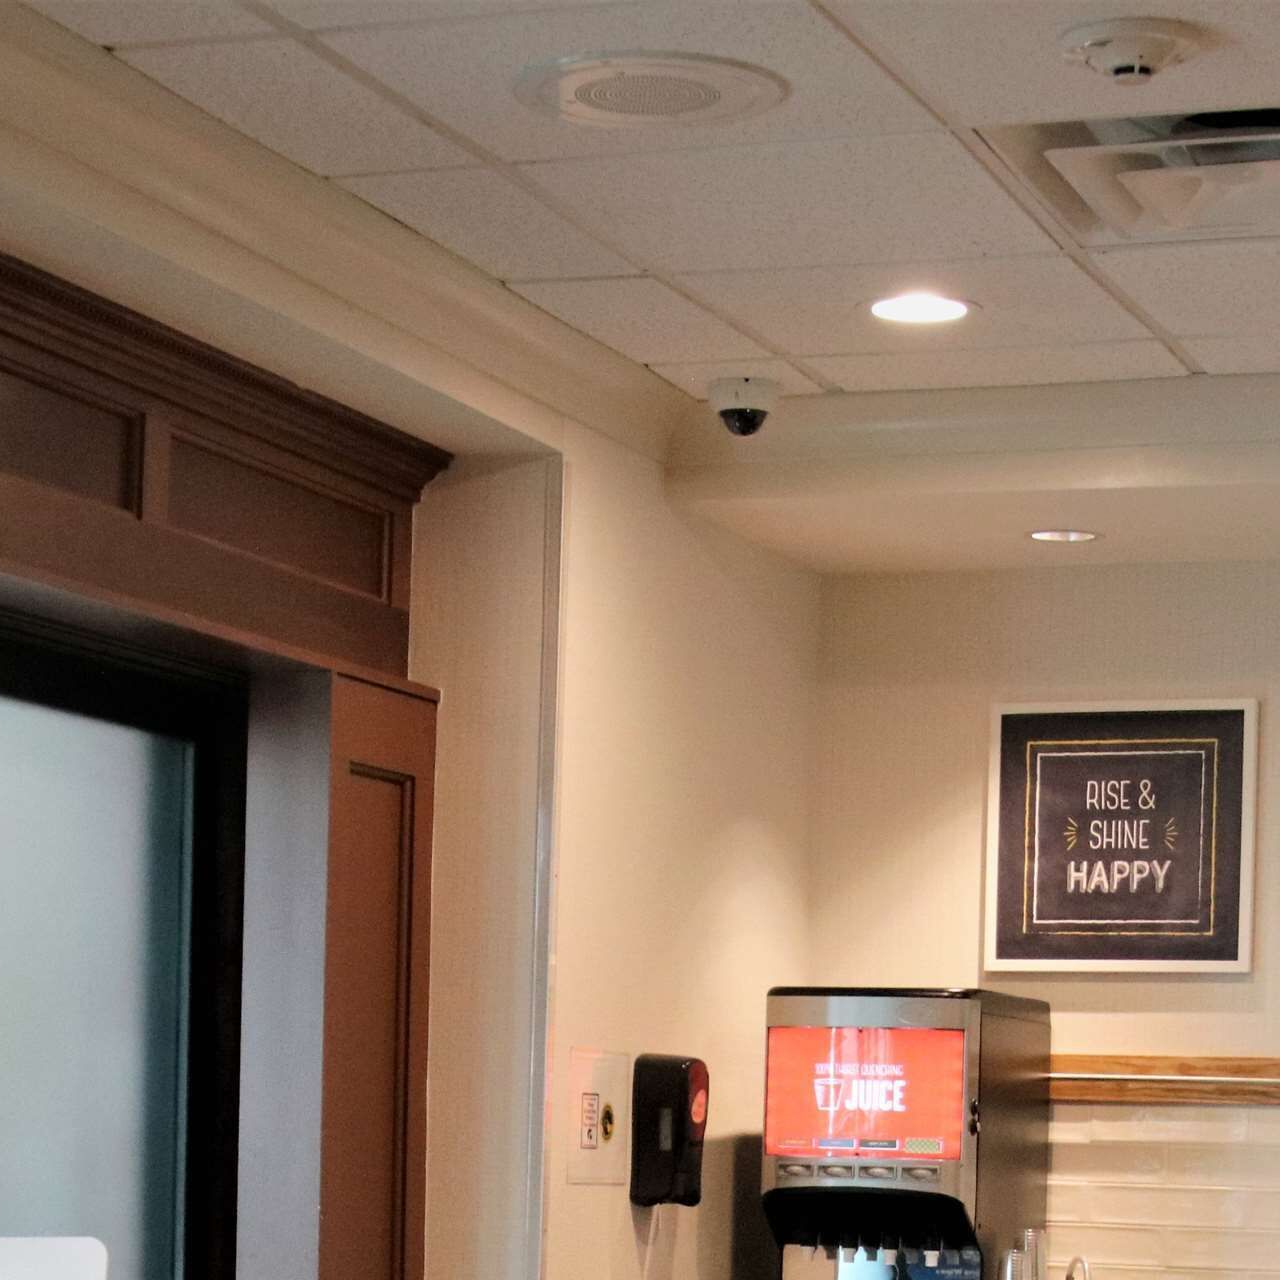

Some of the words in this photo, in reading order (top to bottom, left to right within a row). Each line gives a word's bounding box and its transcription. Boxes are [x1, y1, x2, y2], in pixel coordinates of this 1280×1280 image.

[1086, 780, 1131, 810] RISE
[1137, 779, 1155, 809] &
[1089, 819, 1150, 849] SHINE
[1067, 860, 1171, 893] HAPPY
[845, 1080, 906, 1112] JUICE
